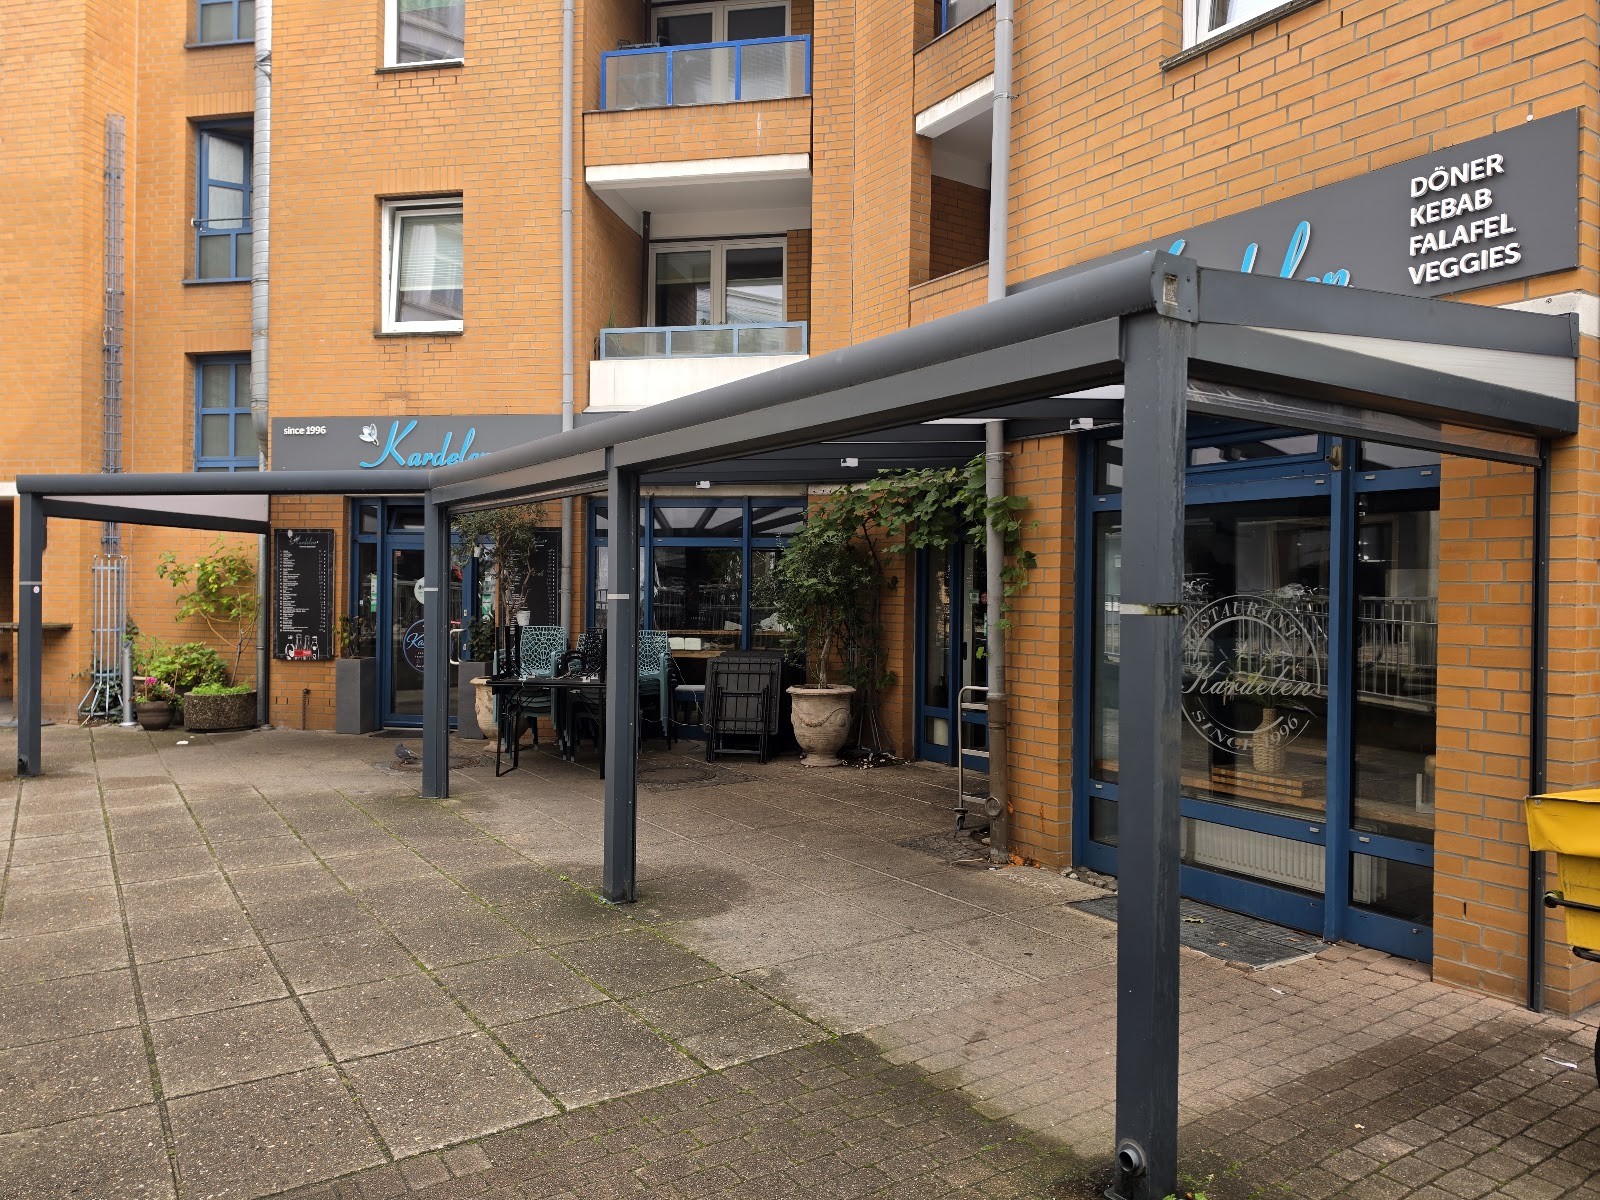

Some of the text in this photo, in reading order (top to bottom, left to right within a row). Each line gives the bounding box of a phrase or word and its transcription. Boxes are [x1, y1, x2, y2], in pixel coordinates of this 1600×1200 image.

[1410, 153, 1504, 198] DÖNER
[1410, 188, 1493, 227] KEBAB
[1409, 213, 1517, 256] FALAFEL
[1408, 243, 1522, 285] VEGGIES
[283, 426, 327, 435] since 1996
[359, 419, 493, 468] Kardele
[1182, 661, 1315, 697] Kardelen
